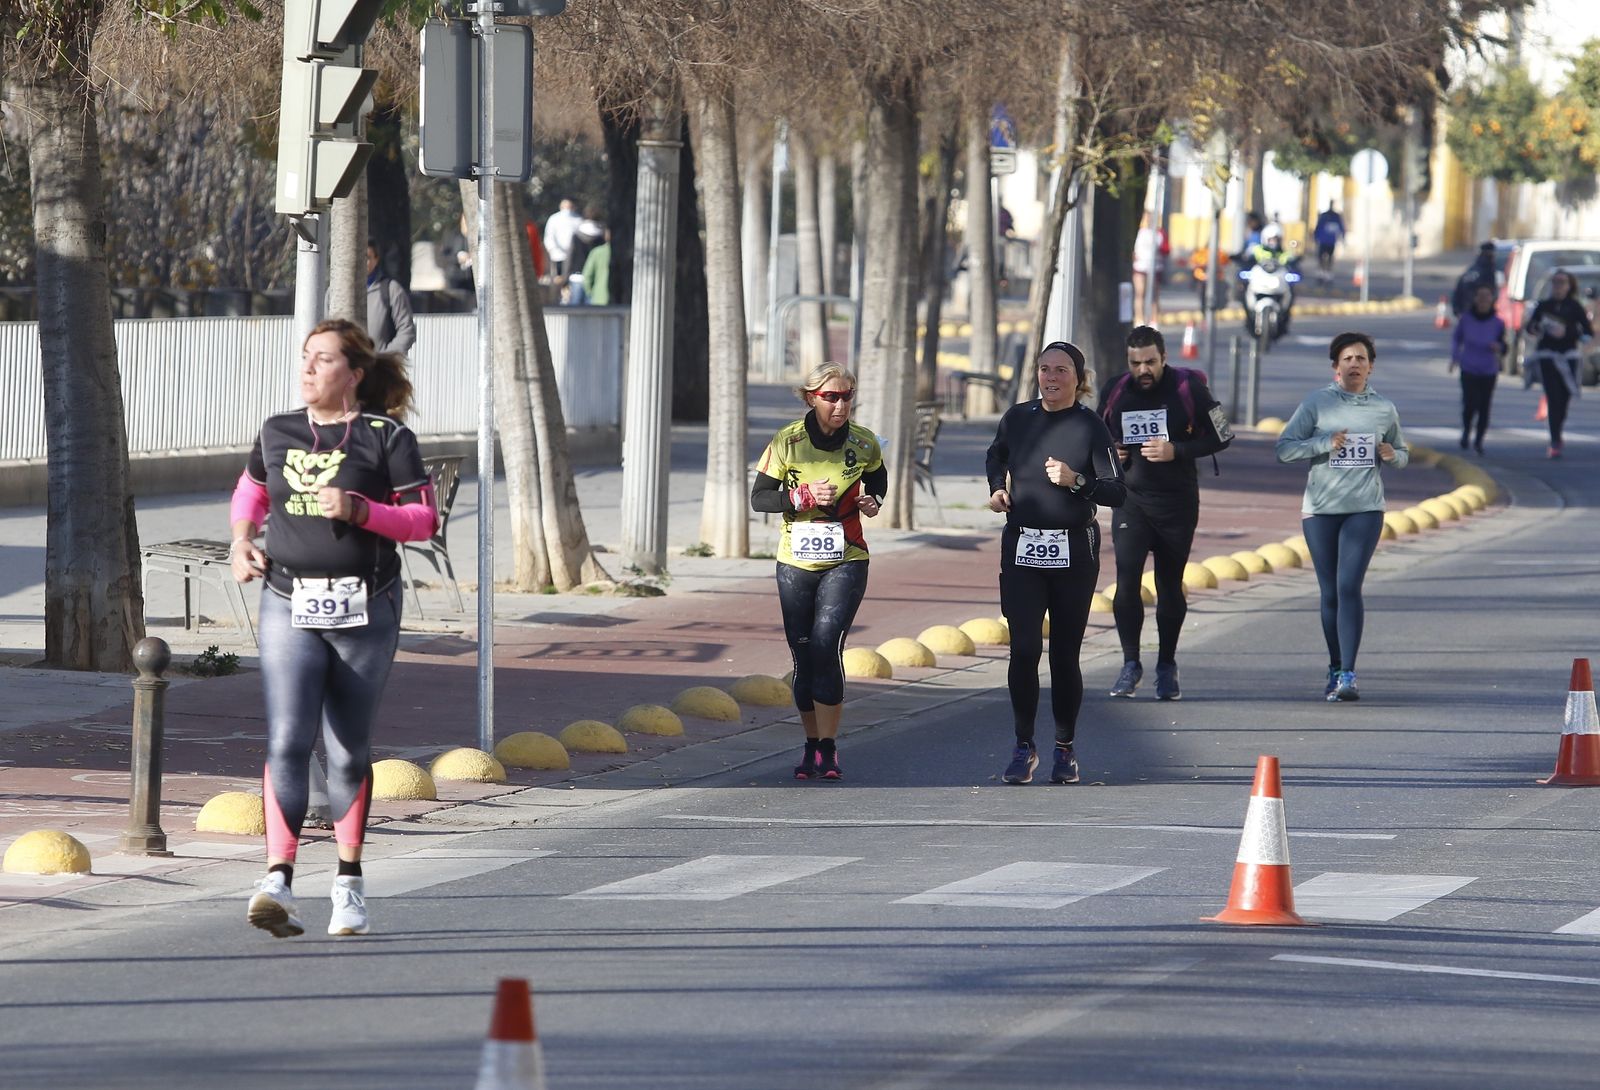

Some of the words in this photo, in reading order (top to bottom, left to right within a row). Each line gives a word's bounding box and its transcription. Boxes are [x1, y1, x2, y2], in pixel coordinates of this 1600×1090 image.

[1130, 422, 1160, 435] 318
[1338, 446, 1367, 458] 319
[800, 537, 835, 551] 298
[802, 552, 841, 560] CORDOBARIA
[1025, 543, 1060, 558] 299
[1026, 558, 1067, 566] CORDOBARIA
[306, 598, 350, 615] 391
[295, 616, 306, 624] LA
[307, 615, 363, 625] CORDOBARIA
